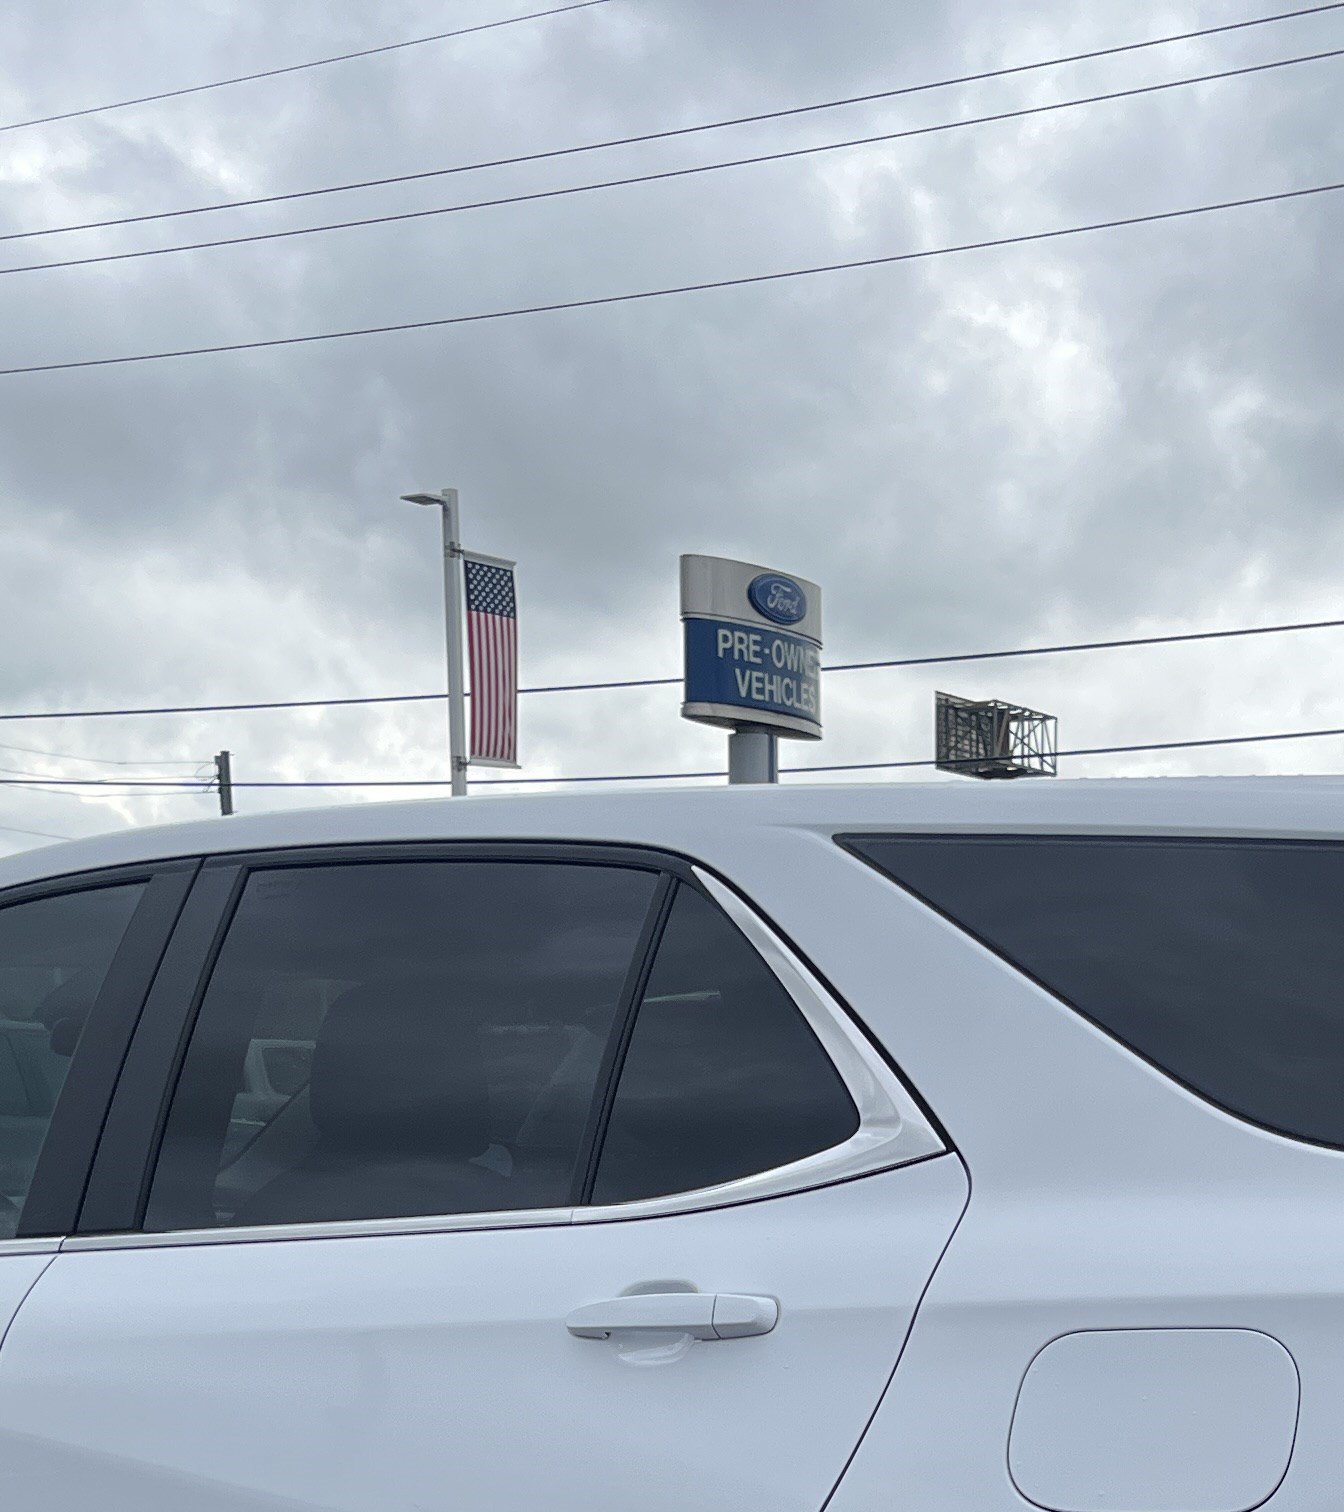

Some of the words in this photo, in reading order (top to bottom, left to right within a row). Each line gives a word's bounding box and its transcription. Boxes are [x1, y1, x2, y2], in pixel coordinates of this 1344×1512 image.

[766, 582, 801, 615] Ford
[717, 628, 820, 681] PRE-OWNE
[735, 668, 817, 716] VEHICLES
